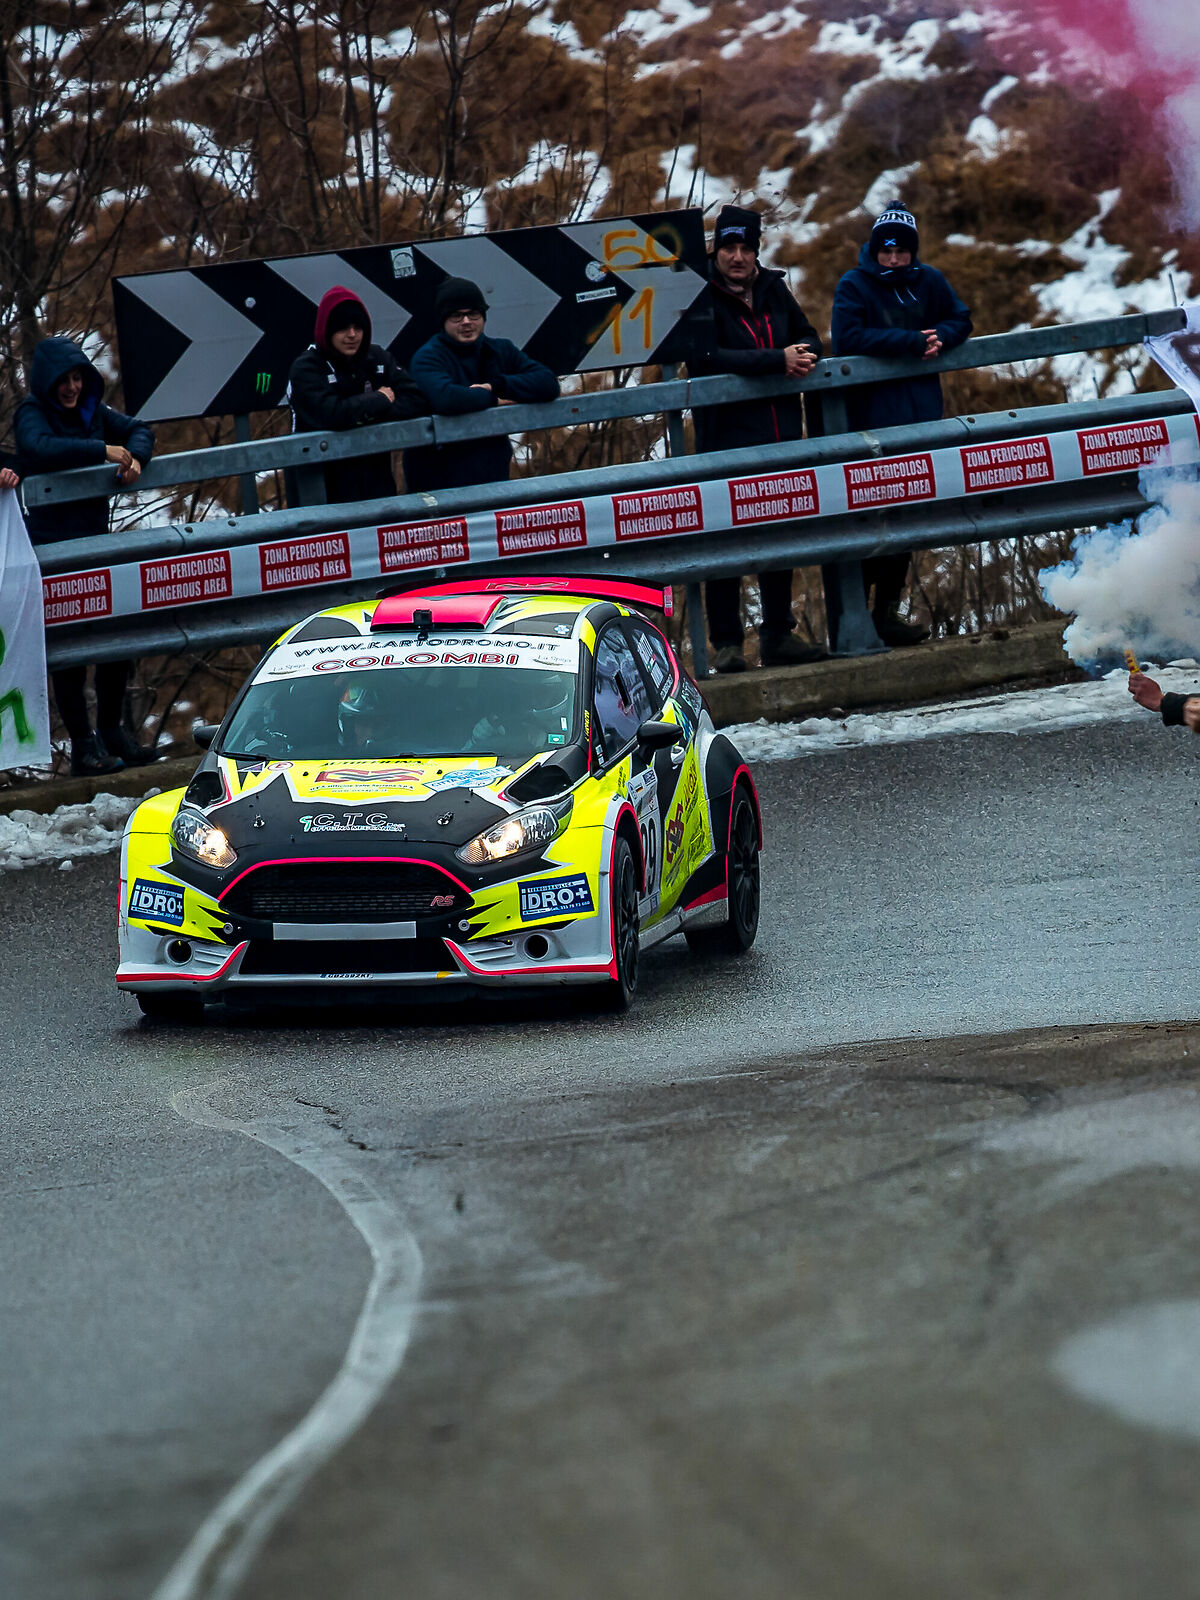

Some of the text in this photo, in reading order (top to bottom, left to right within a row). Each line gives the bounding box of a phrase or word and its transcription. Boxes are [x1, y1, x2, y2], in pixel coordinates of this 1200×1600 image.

[1082, 425, 1164, 450] ZONA PERICOLOSA
[965, 442, 1047, 468] ZONA PERICOLOSA
[1086, 449, 1141, 471] DANGEROUS
[849, 459, 929, 484] ZONA PERICOLOSA
[969, 462, 1049, 488] DANGEROUS AREA
[734, 475, 813, 500] ZONA PERICOLOSA
[852, 479, 931, 504] DANGEROUS AREA
[617, 490, 697, 516] ZONA PERICOLOSA
[736, 495, 815, 520] DANGEROUS AREA
[501, 506, 580, 531] ZONA PERICOLOSA
[619, 511, 699, 536] DANGEROUS AREA
[382, 522, 463, 548] ZONA PERICOLOSA
[502, 526, 582, 551] DANGEROUS AREA
[264, 539, 345, 566] ZONA PERICOLOSA
[384, 542, 465, 568] DANGEROUS AREA
[145, 557, 226, 584] ZONA PERICOLOSA
[266, 559, 347, 585] DANGEROUS AREA
[51, 575, 107, 598] PERICOLOSA
[147, 577, 227, 604] DANGEROUS AREA
[45, 596, 107, 619] GEROUS AREA
[294, 638, 560, 658] WWW.KARTODROMO.IT
[312, 652, 519, 673] COLOMBI
